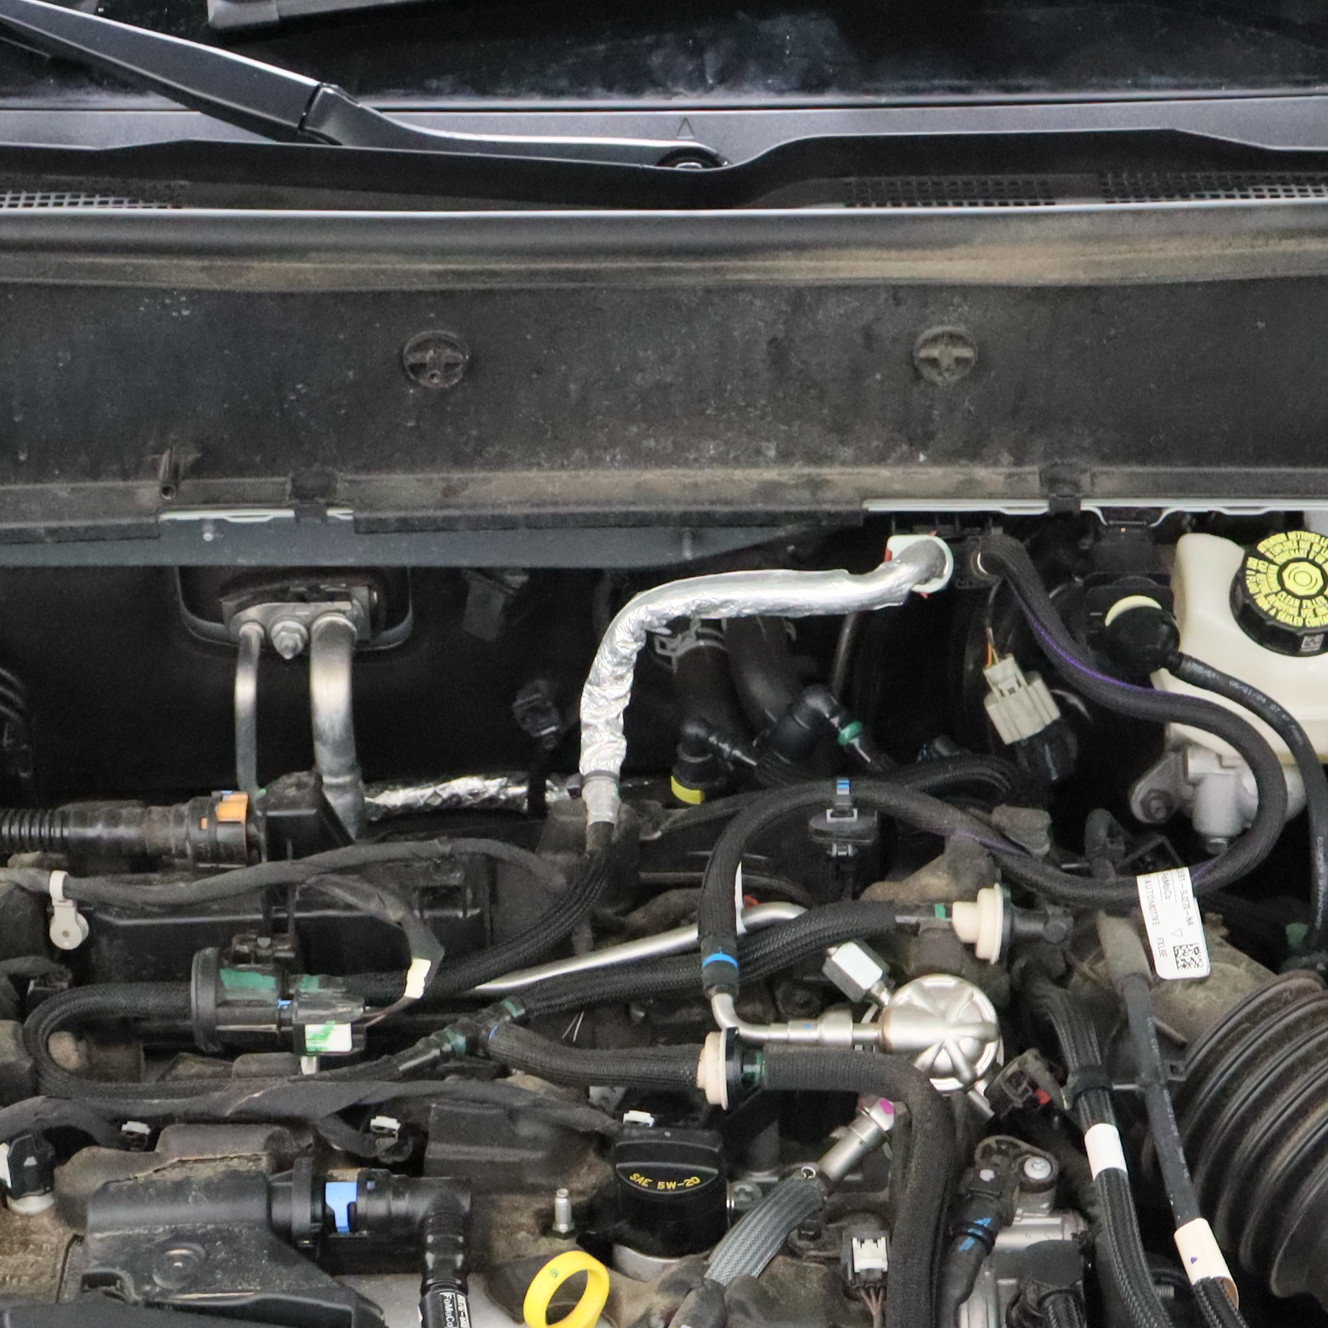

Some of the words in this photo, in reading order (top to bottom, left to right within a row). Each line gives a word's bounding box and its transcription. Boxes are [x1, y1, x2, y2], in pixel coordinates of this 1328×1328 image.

[629, 1172, 653, 1187] SAE
[657, 1175, 701, 1190] 5W-20
[440, 1292, 455, 1328] FoMoCo
